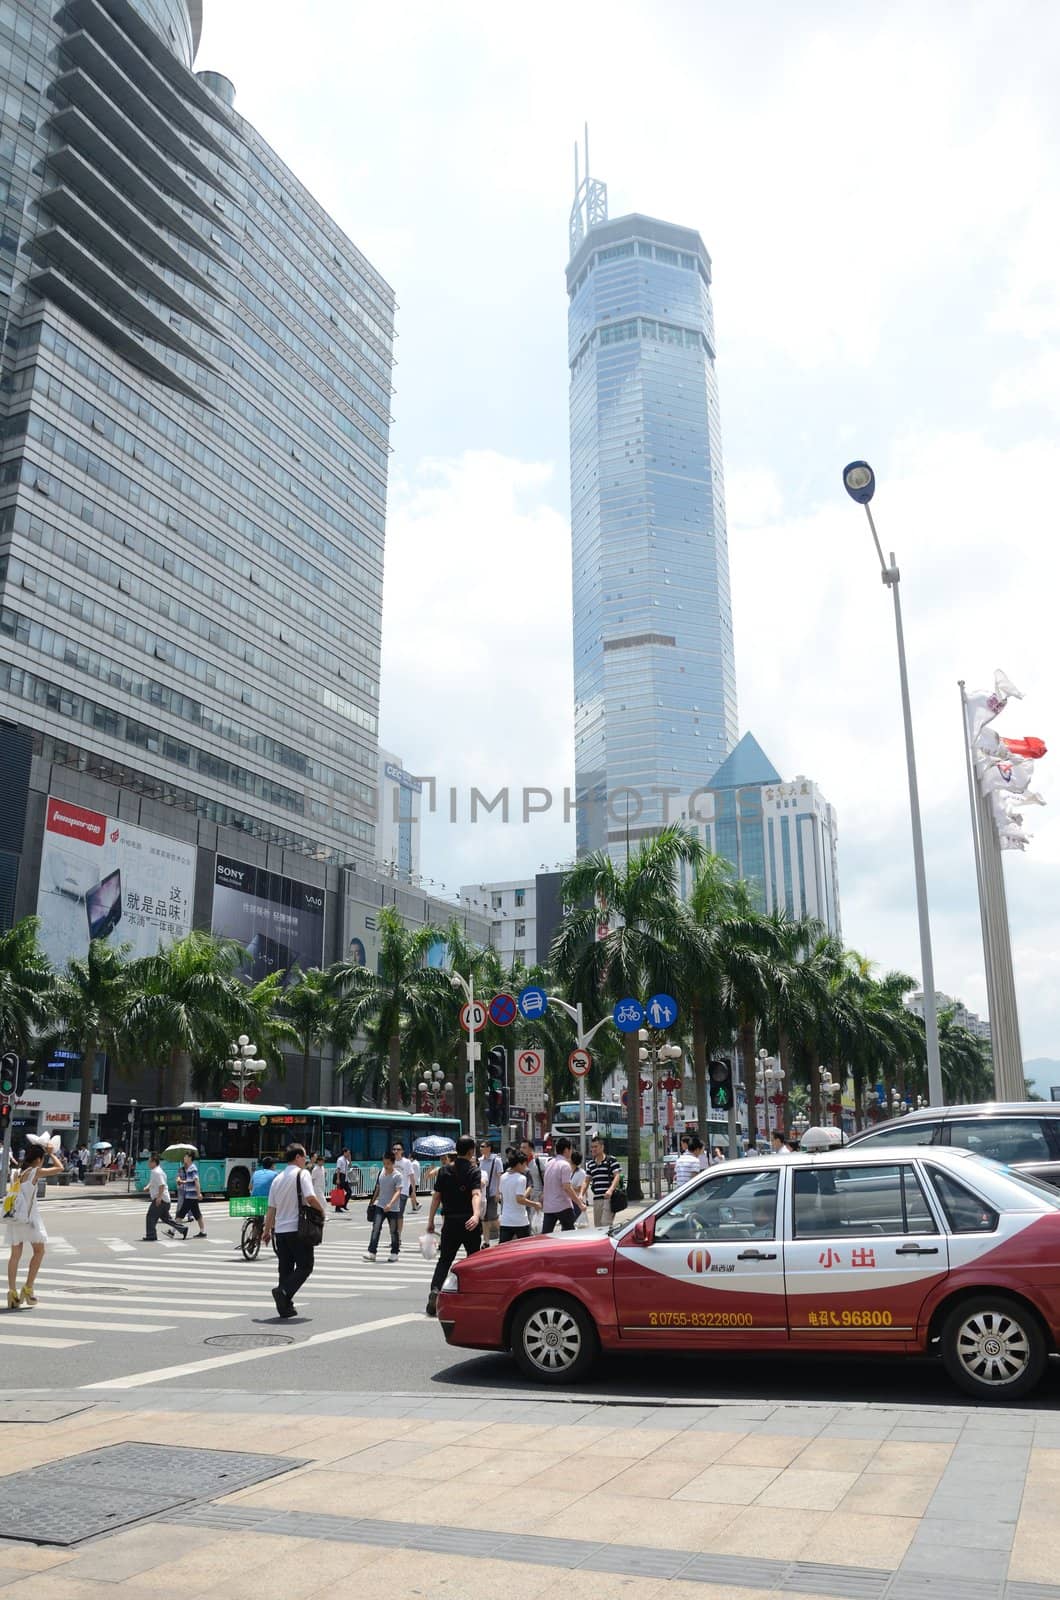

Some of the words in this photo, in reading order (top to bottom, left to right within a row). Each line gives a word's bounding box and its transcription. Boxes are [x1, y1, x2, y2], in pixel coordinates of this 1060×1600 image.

[217, 864, 245, 880] SONY
[305, 895, 322, 906] VAIO
[818, 1248, 876, 1268] 小出
[659, 1312, 753, 1326] 0755-83228000
[808, 1311, 829, 1326] 电召
[841, 1311, 892, 1326] 96800
